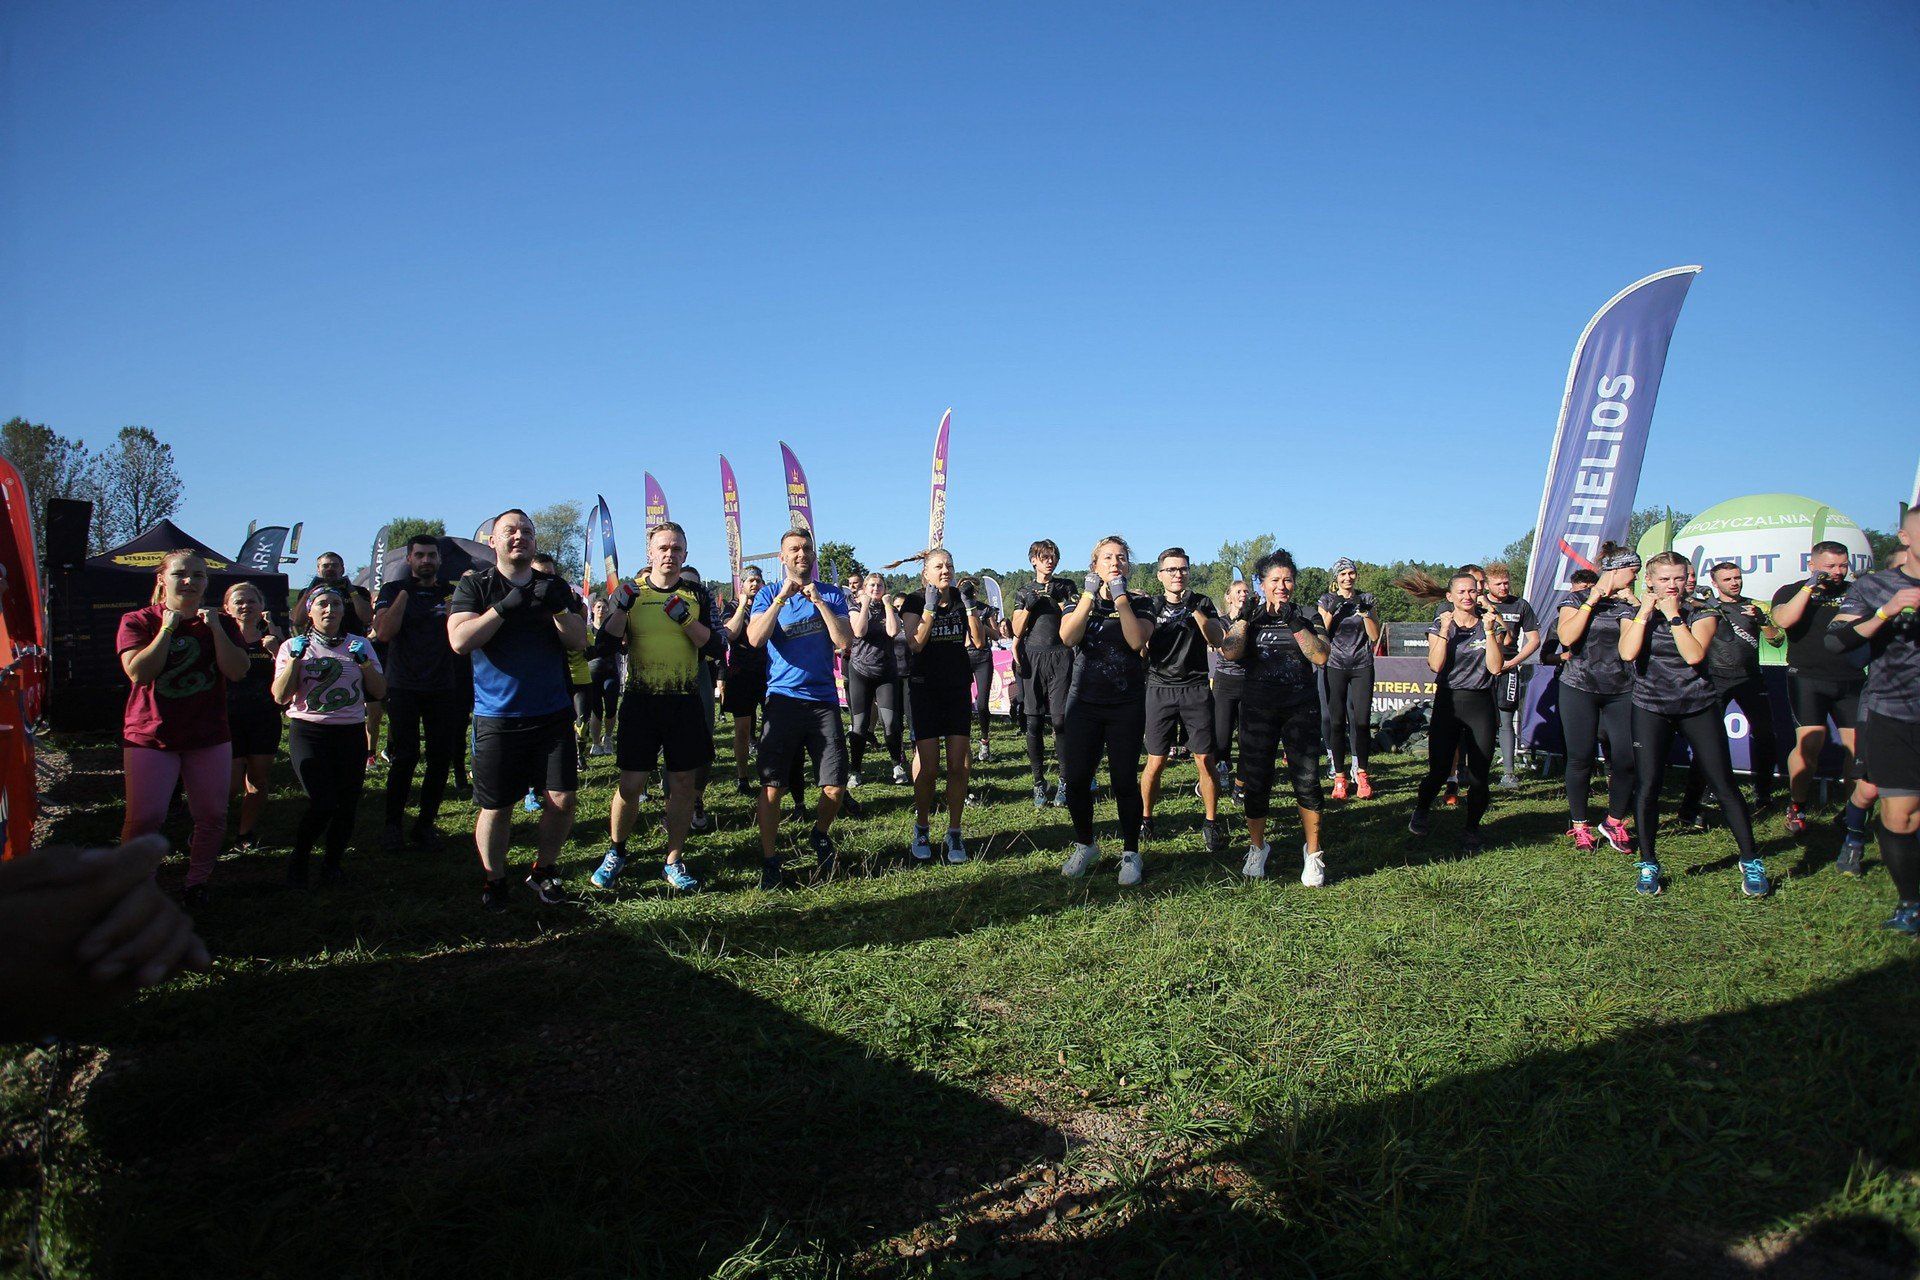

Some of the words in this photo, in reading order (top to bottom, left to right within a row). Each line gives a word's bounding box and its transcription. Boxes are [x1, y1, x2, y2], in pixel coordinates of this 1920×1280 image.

[1568, 374, 1636, 525] HELIOS
[252, 541, 274, 571] ARK
[373, 541, 385, 591] MARK
[931, 624, 964, 637] SIŁA!
[1374, 681, 1422, 694] STREFA
